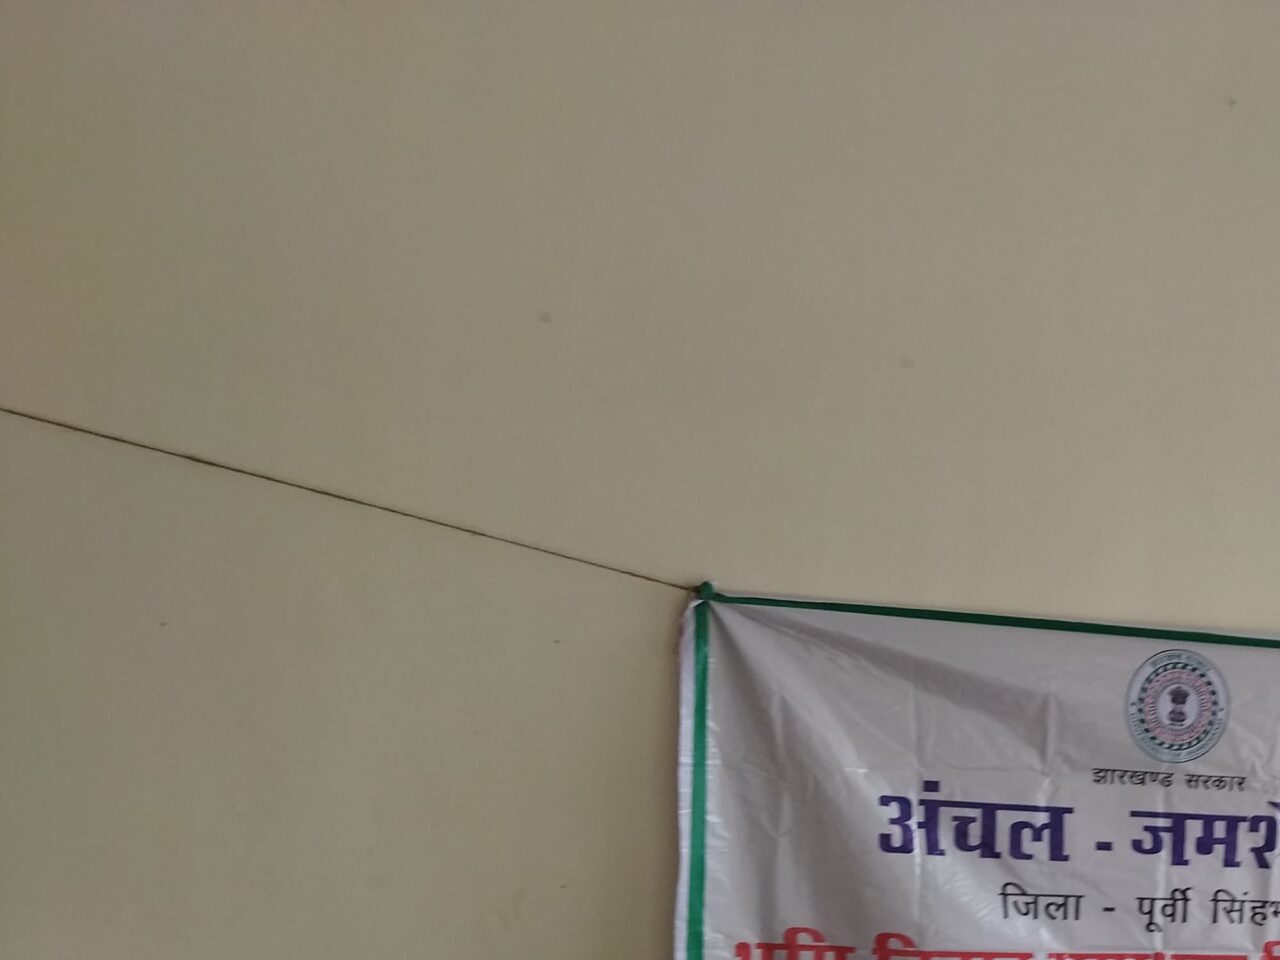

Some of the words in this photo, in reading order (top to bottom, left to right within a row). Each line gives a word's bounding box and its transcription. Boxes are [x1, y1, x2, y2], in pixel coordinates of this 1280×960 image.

[1092, 767, 1175, 788] झारखण्ड
[1183, 773, 1248, 792] सरकार
[879, 780, 1074, 862] अंचल
[998, 882, 1085, 921] जिला
[1136, 887, 1194, 934] पूर्वी
